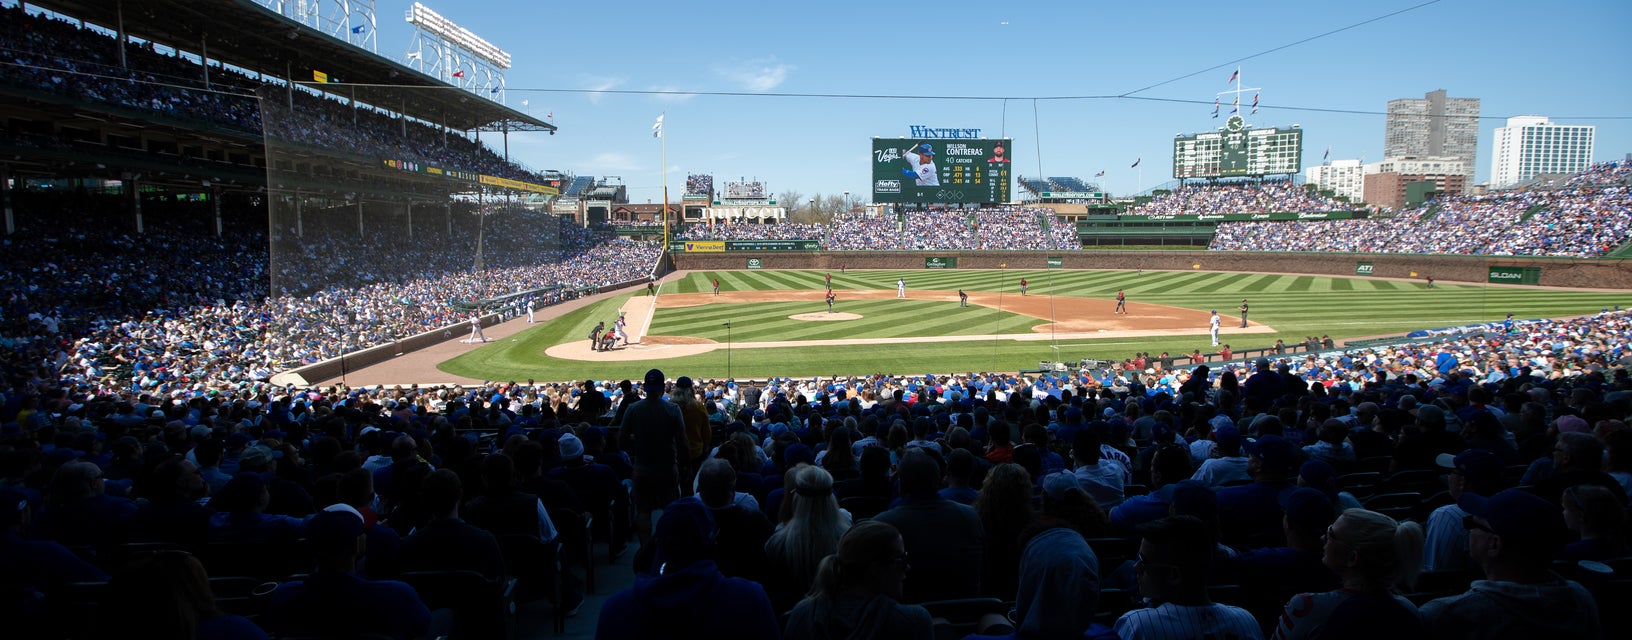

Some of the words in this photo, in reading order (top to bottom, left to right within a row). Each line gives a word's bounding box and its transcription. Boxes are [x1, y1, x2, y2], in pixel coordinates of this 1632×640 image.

[874, 149, 901, 163] Vegas
[946, 148, 983, 156] CONTRERAS
[700, 207, 786, 219] nuveen
